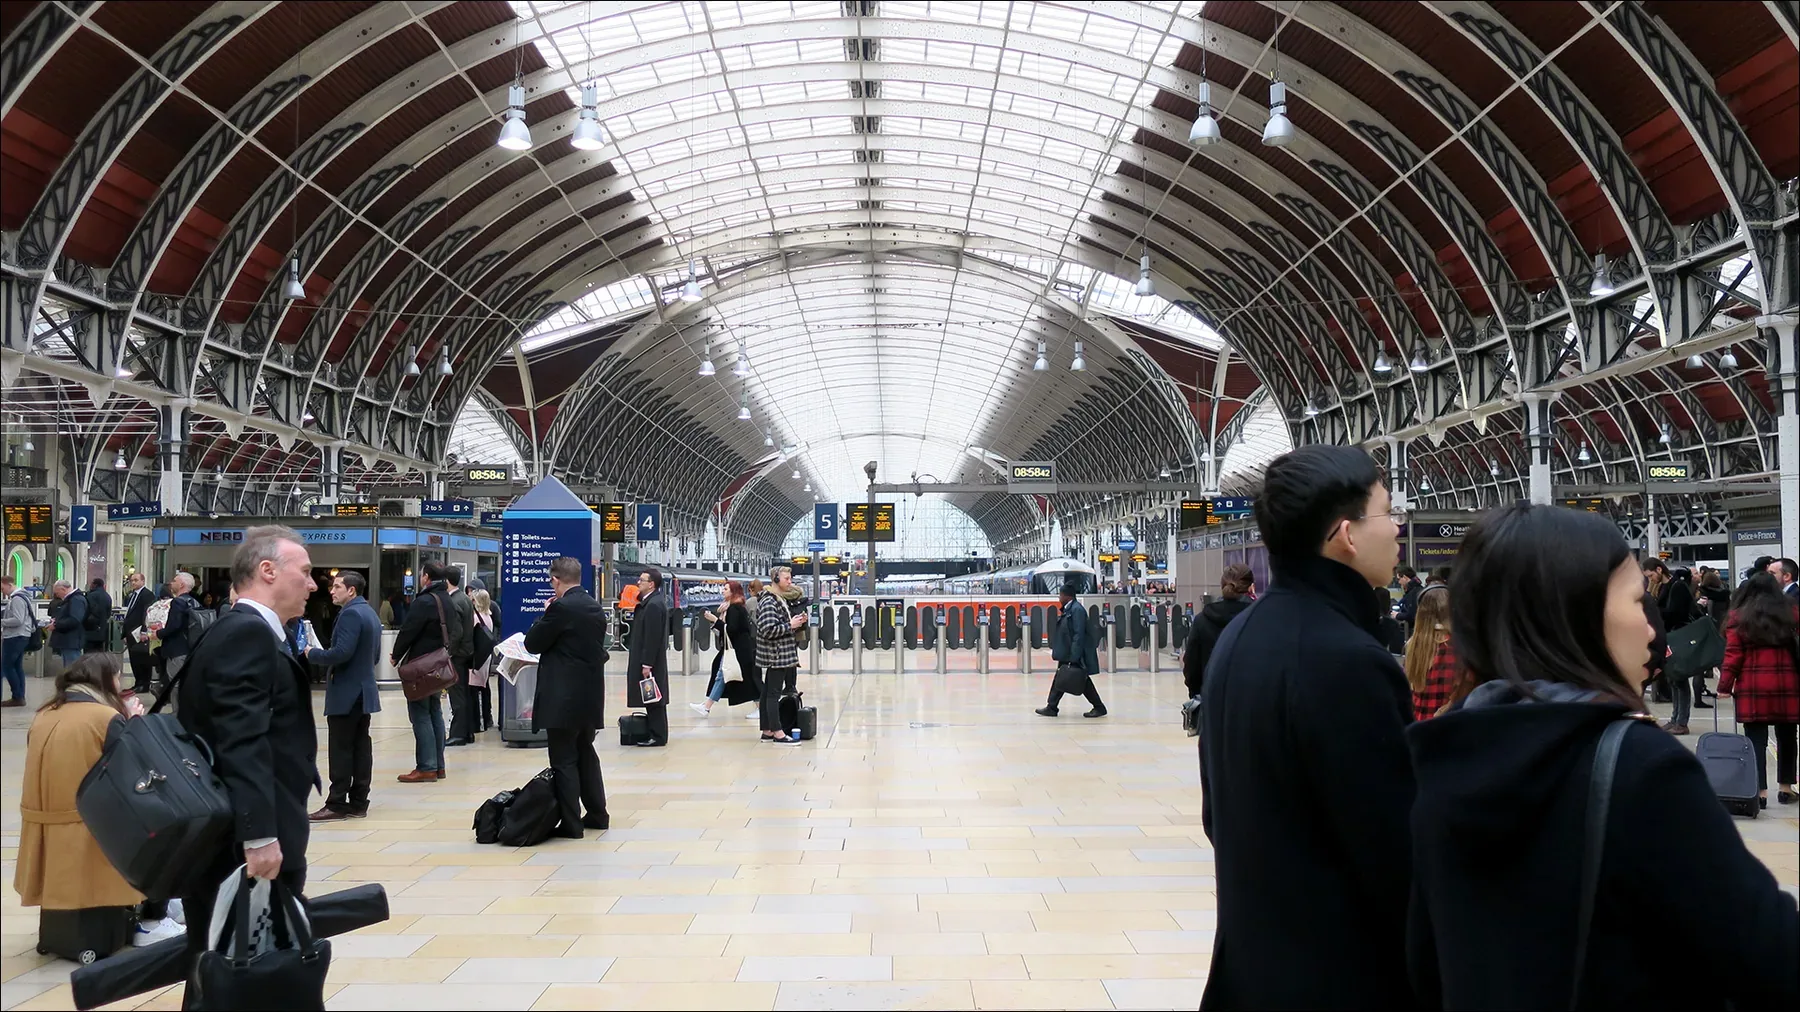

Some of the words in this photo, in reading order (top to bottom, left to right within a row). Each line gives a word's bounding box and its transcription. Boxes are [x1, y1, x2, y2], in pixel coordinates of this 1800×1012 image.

[77, 516, 88, 532] 2
[642, 515, 654, 530] 4
[821, 514, 832, 529] 5
[1757, 531, 1776, 540] France
